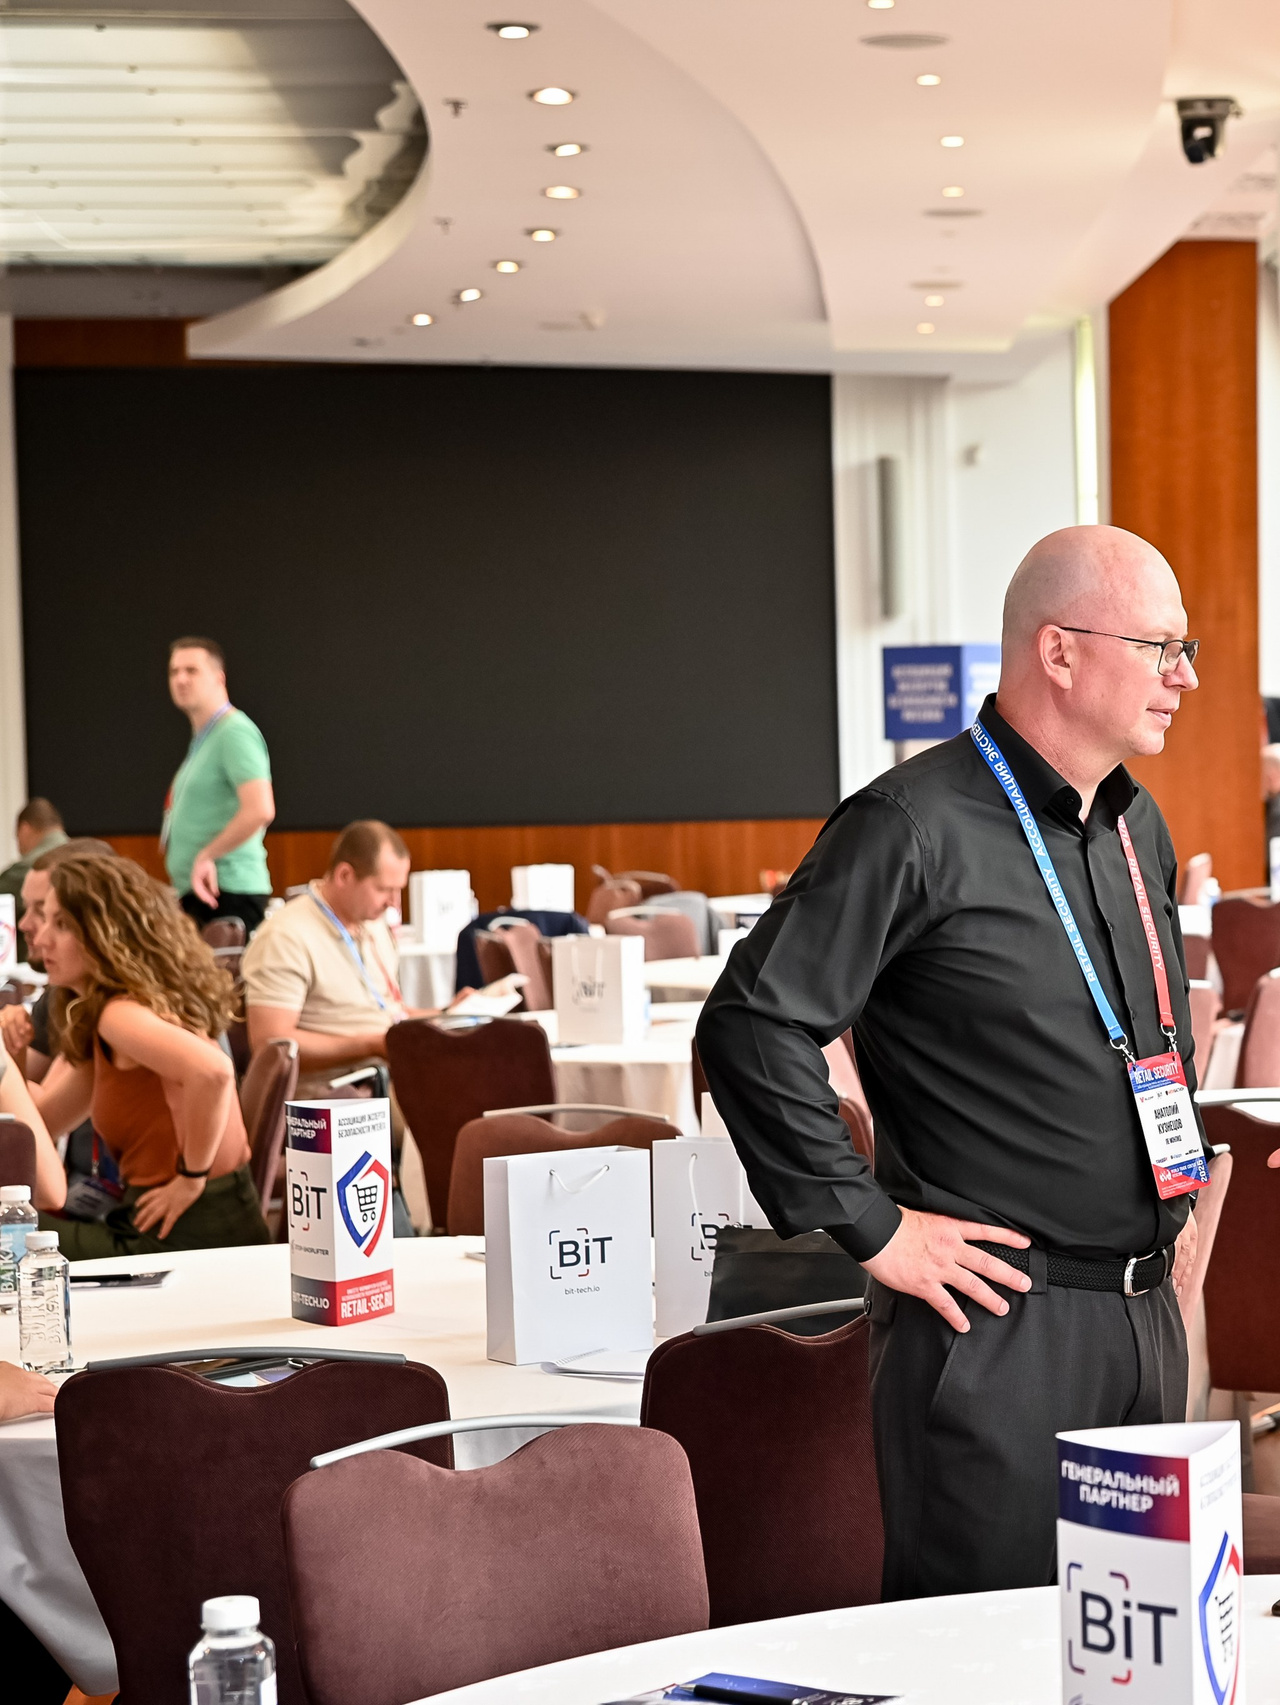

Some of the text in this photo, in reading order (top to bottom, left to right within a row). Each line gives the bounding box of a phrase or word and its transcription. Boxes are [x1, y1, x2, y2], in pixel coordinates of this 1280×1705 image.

[994, 761, 1046, 857] АССОЦИАЦИЯ
[1043, 868, 1096, 983] RETAIL SECURITY
[1128, 858, 1163, 970] RETAIL SECURITY
[292, 1184, 327, 1220] BiT
[558, 1236, 613, 1268] BiT
[564, 1285, 600, 1295] bit-tech.io
[1061, 1460, 1180, 1497] ГЕНЕРАЛЬНЫЙ
[1079, 1486, 1154, 1513] ПАРТНЕР
[1080, 1591, 1178, 1665] BiT
